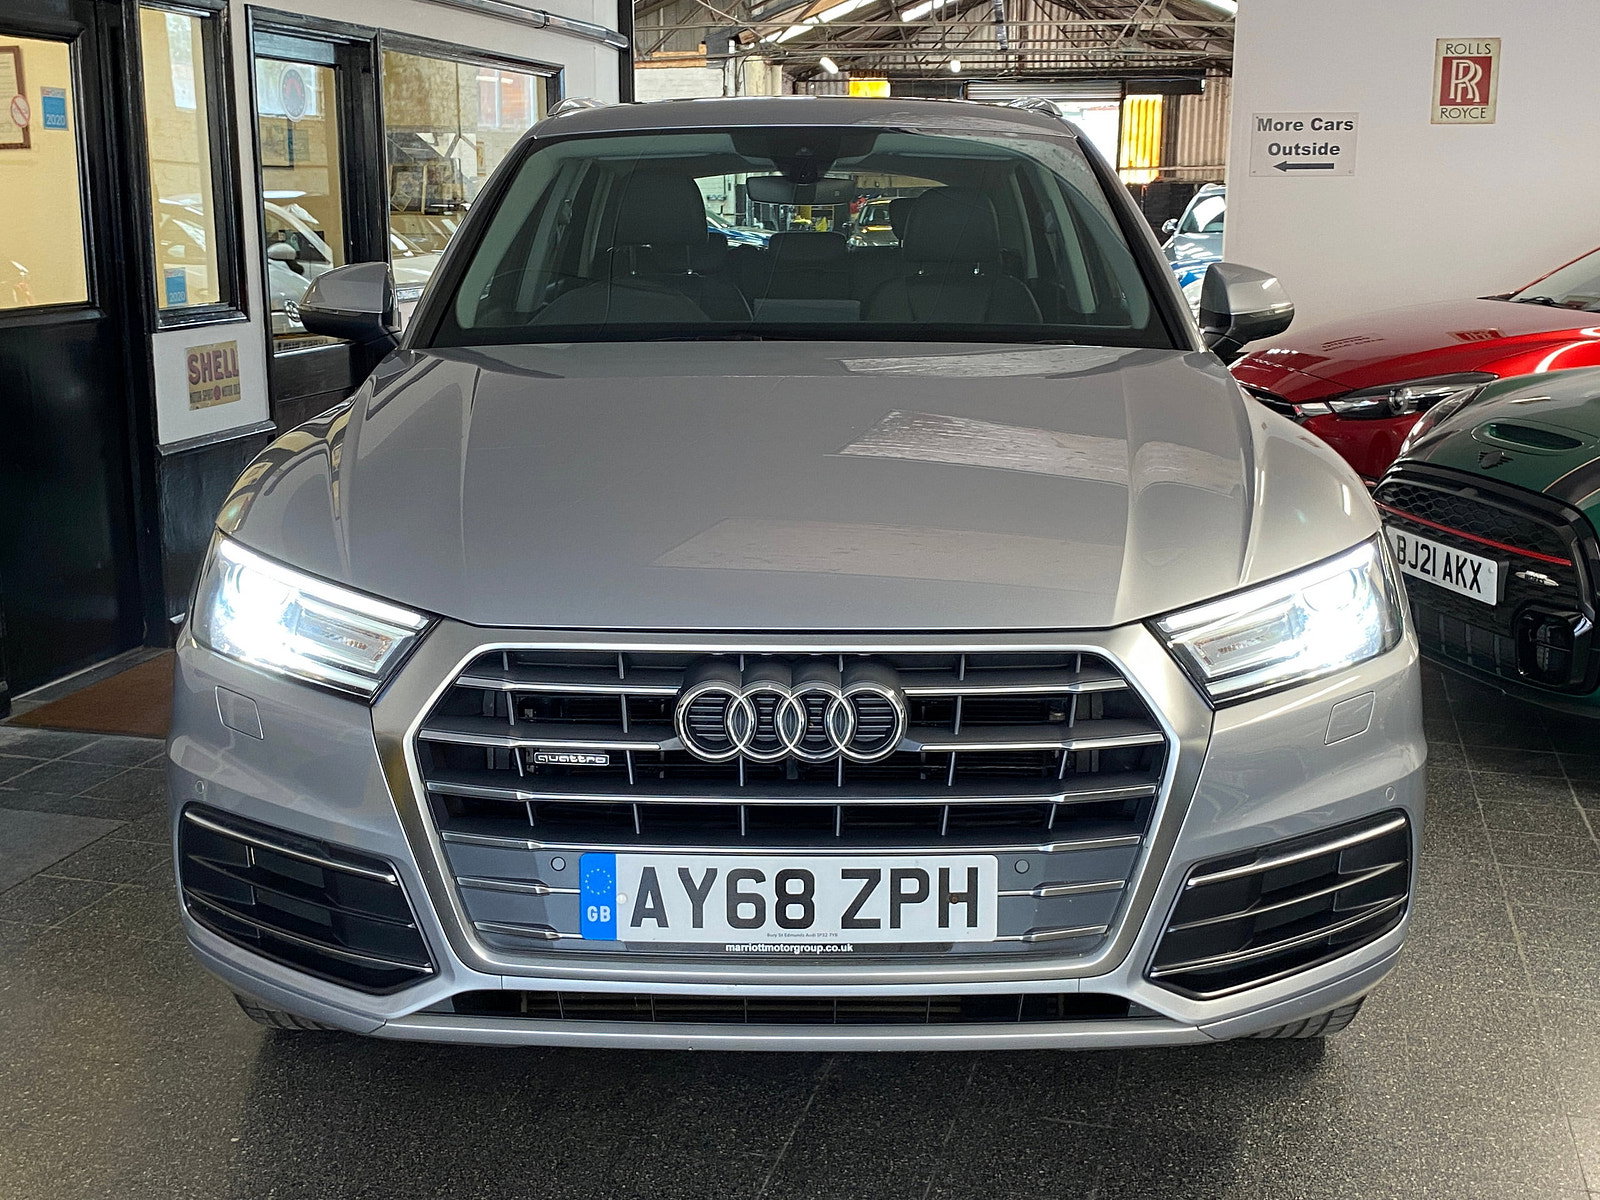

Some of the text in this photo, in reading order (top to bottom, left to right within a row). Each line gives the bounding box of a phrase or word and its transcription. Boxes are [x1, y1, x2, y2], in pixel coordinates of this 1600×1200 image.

[1445, 43, 1492, 55] ROLLS
[46, 113, 66, 126] 2020
[1440, 107, 1487, 119] ROYCE
[1257, 117, 1354, 132] More Cars
[1267, 142, 1341, 156] Outside
[187, 347, 240, 386] SHELL
[1396, 534, 1482, 594] BJ21 AKX
[537, 754, 606, 764] quattro
[630, 866, 980, 930] AY68 ZPH
[586, 905, 611, 922] GB
[725, 943, 854, 955] marriottmotorgroup.co.uk
